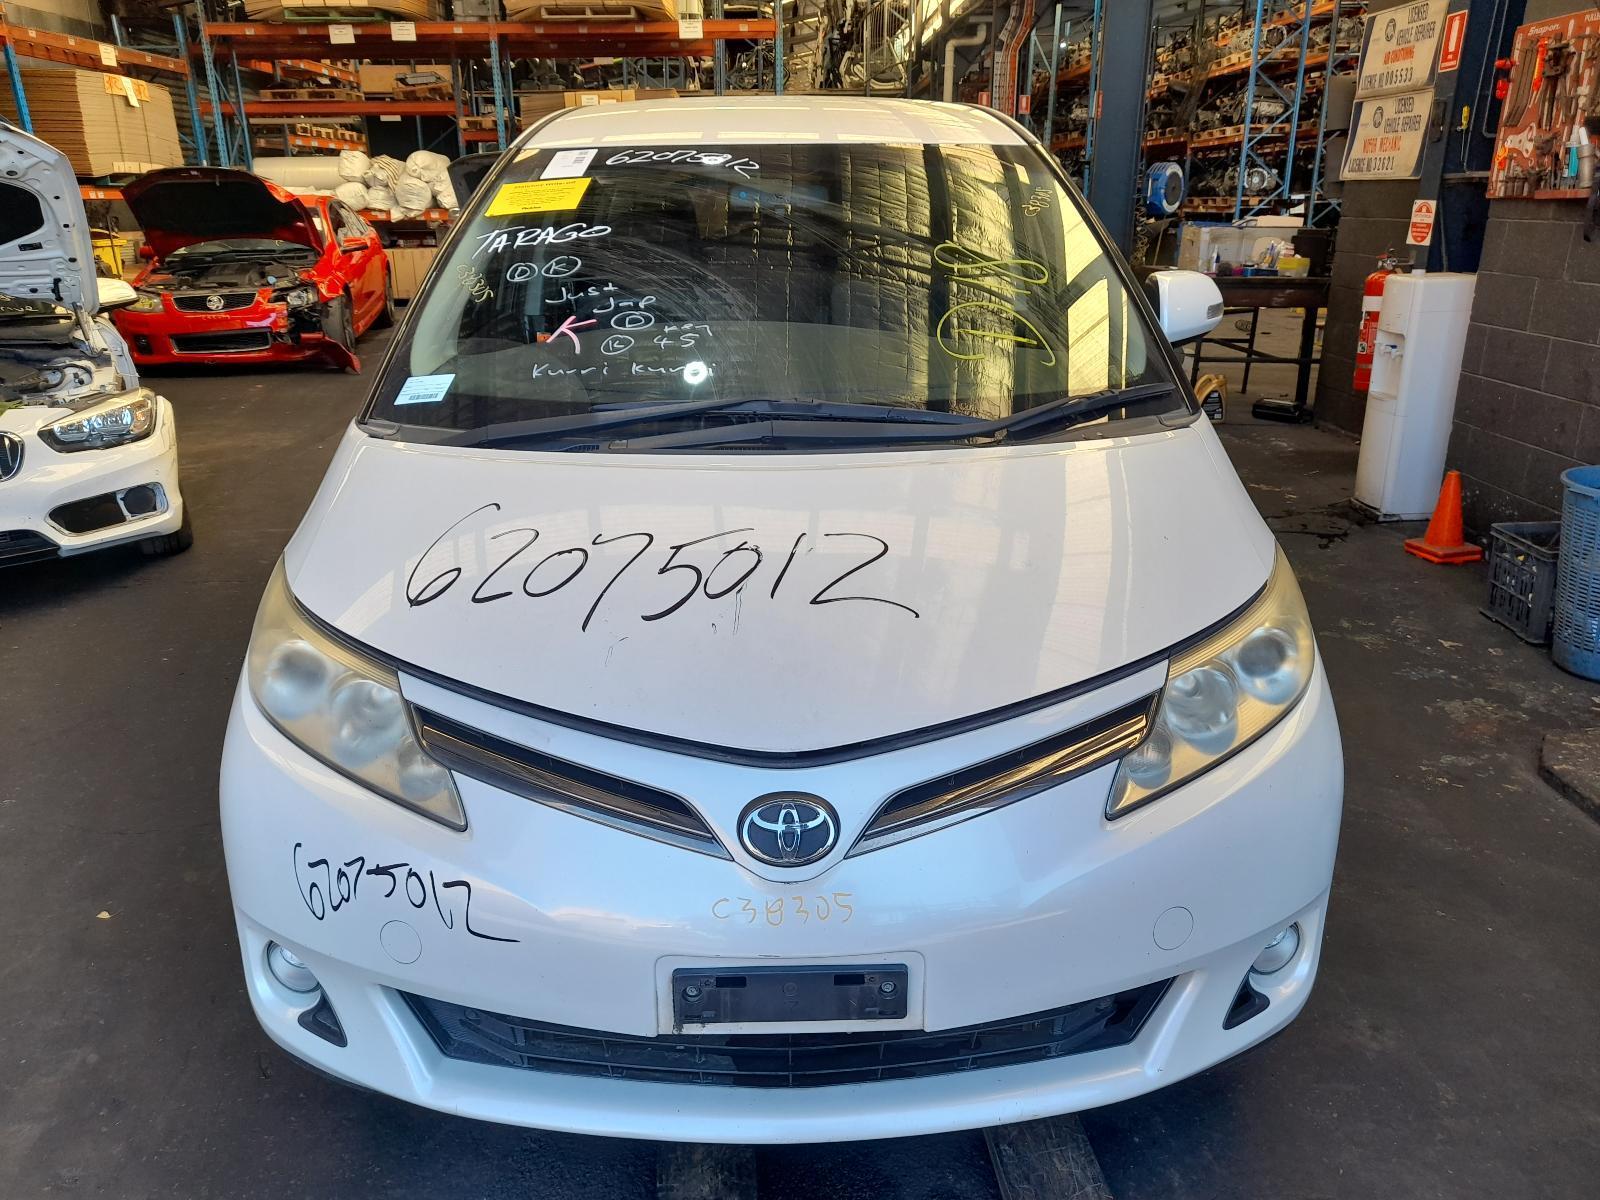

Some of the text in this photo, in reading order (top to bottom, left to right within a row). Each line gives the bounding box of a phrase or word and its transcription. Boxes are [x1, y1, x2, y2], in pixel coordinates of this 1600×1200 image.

[472, 222, 612, 260] TARAGO
[405, 502, 921, 632] 62075012
[293, 842, 521, 943] 62075012
